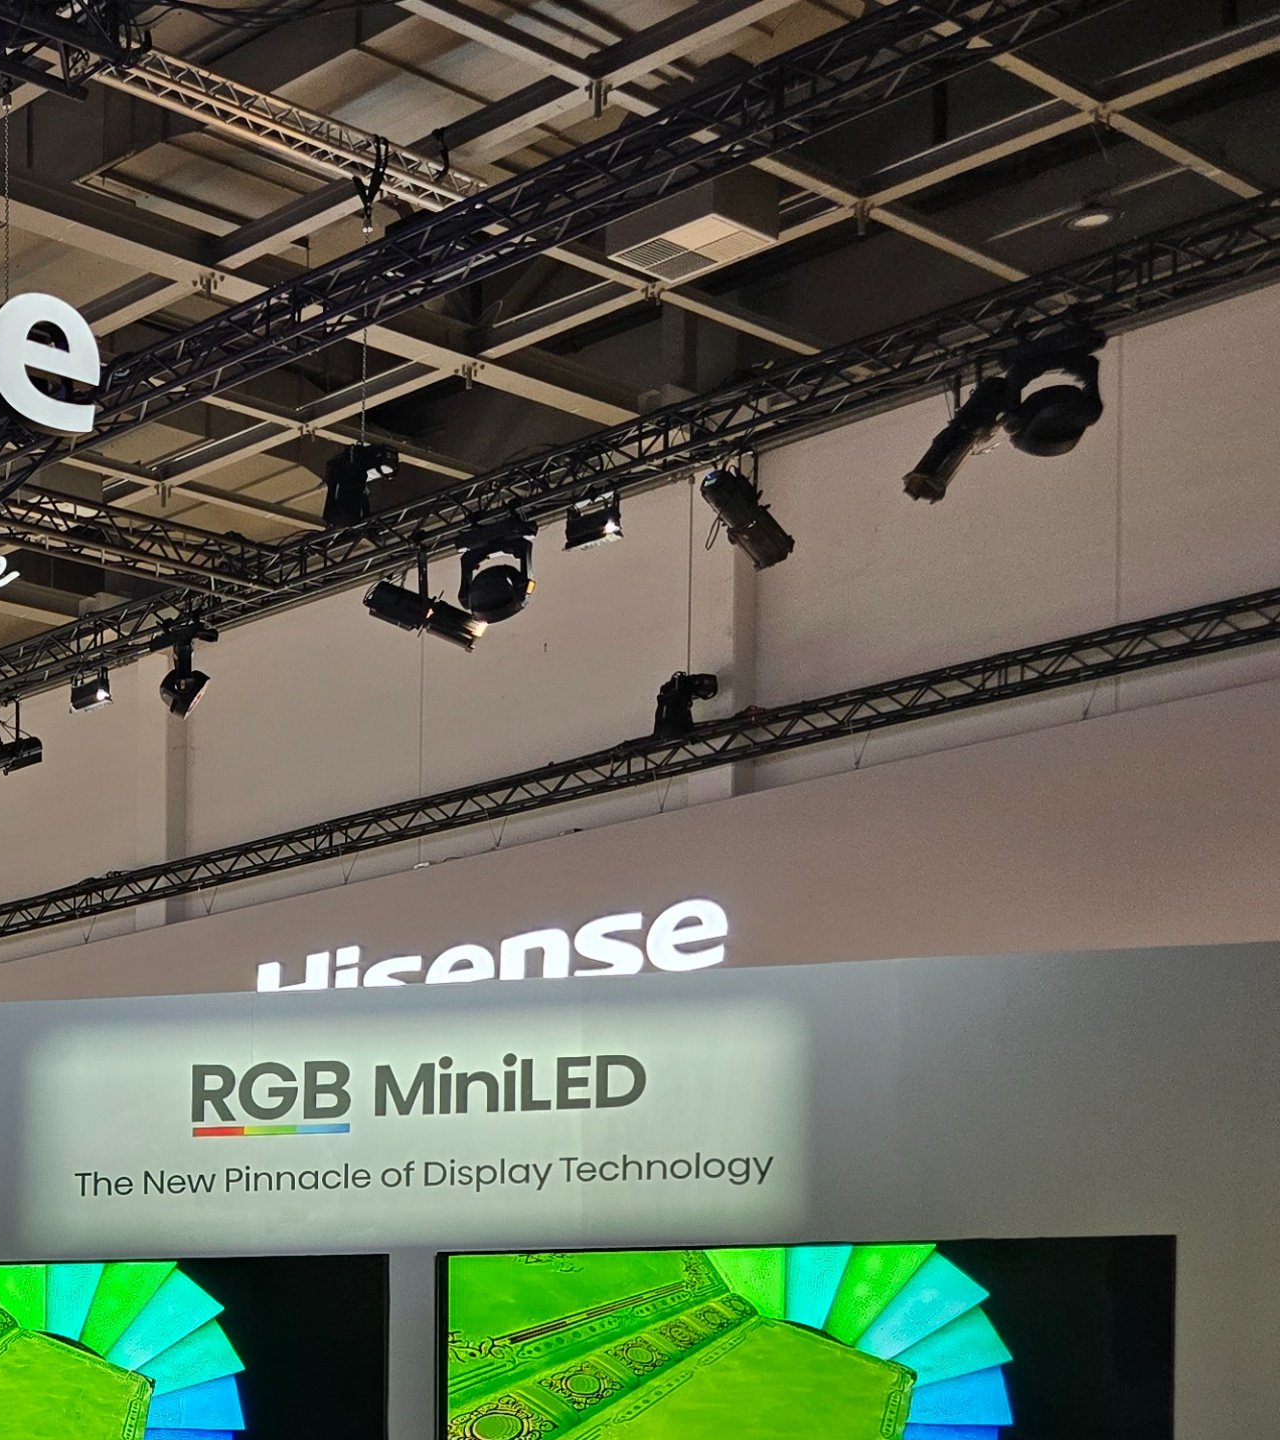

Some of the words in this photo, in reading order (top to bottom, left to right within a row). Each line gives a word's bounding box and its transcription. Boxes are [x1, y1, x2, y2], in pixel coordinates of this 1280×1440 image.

[191, 1060, 352, 1123] RGB
[373, 1053, 647, 1117] MiniLED
[74, 1171, 134, 1197] The
[143, 1169, 217, 1196] New
[225, 1162, 372, 1193] Pinnacle
[380, 1160, 416, 1188] of
[423, 1158, 554, 1193] Display
[558, 1152, 775, 1186] Technology
